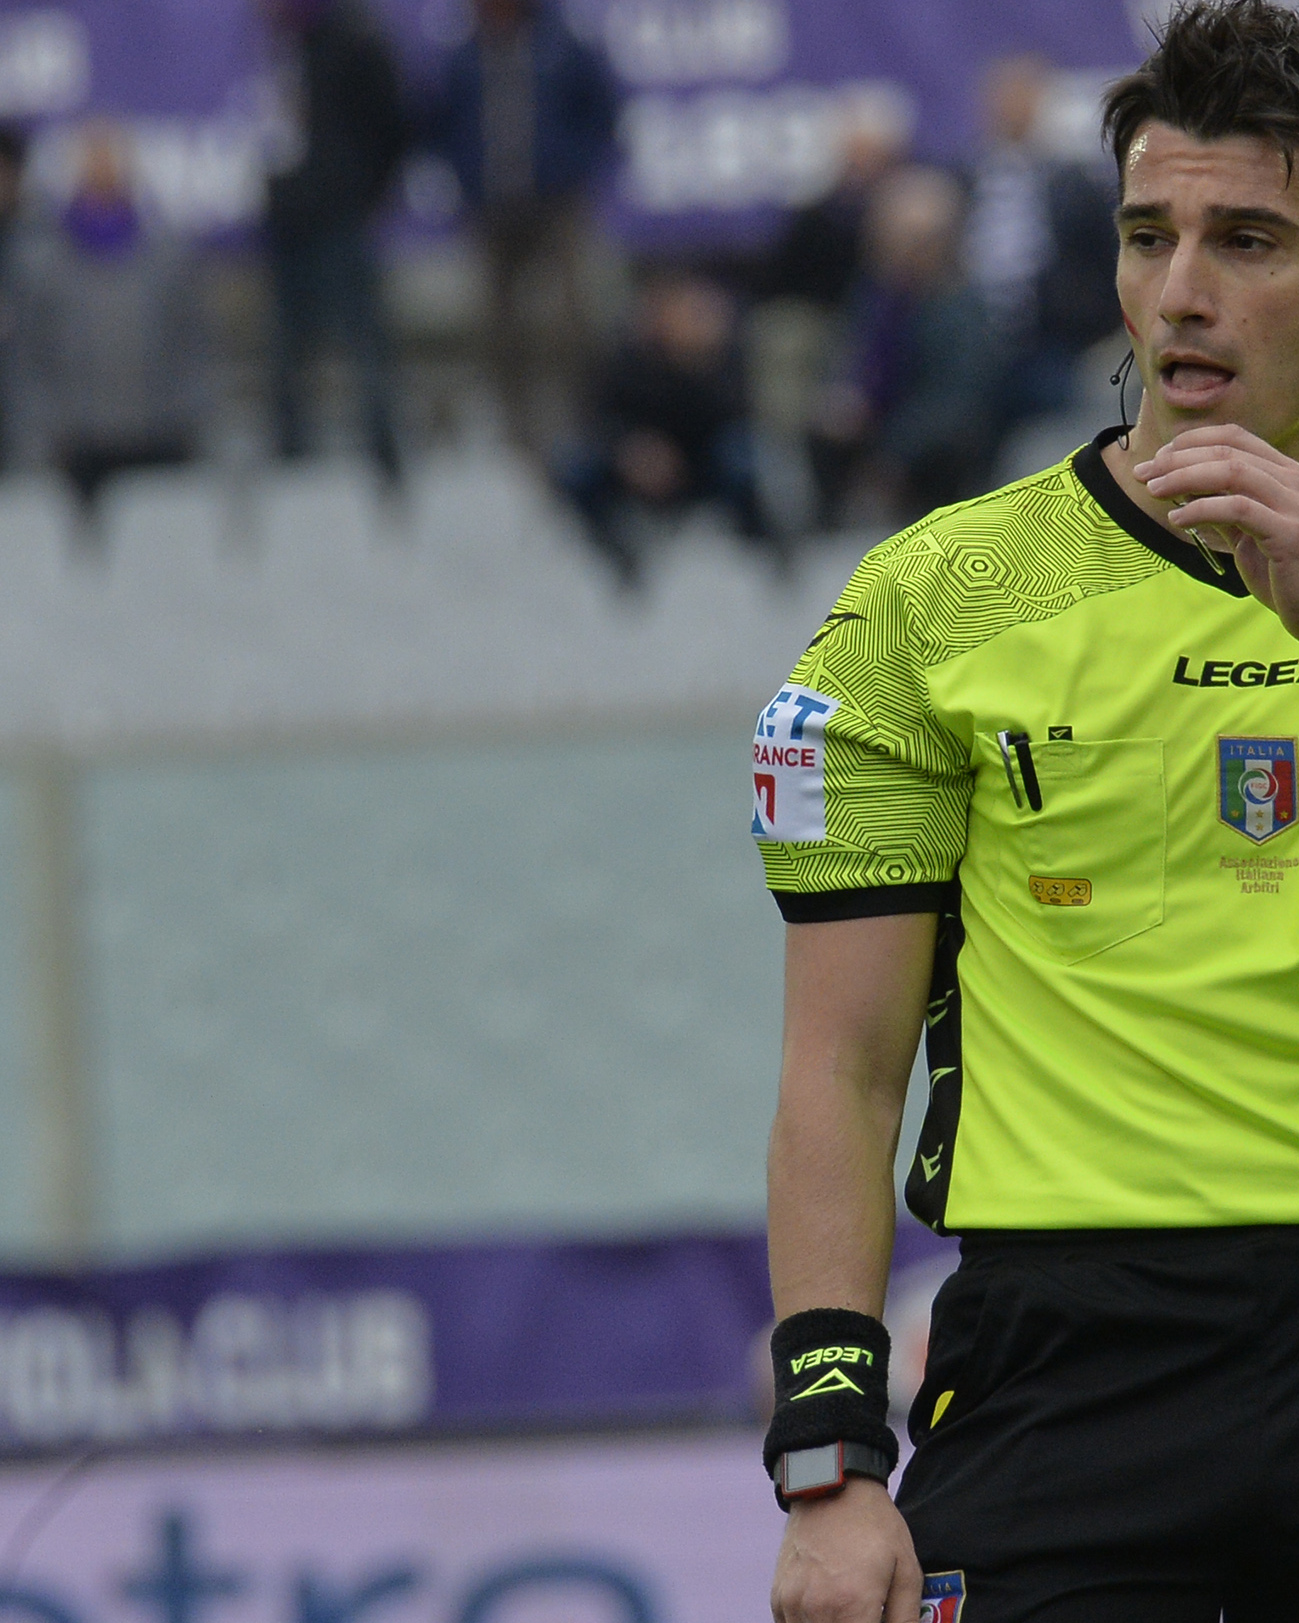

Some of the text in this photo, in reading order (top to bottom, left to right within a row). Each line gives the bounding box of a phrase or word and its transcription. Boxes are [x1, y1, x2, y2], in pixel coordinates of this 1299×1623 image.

[1230, 745, 1285, 756] ITALIA
[1236, 868, 1285, 881] Italiana
[1240, 881, 1280, 894] Arbitri
[790, 1346, 875, 1376] LEGEA
